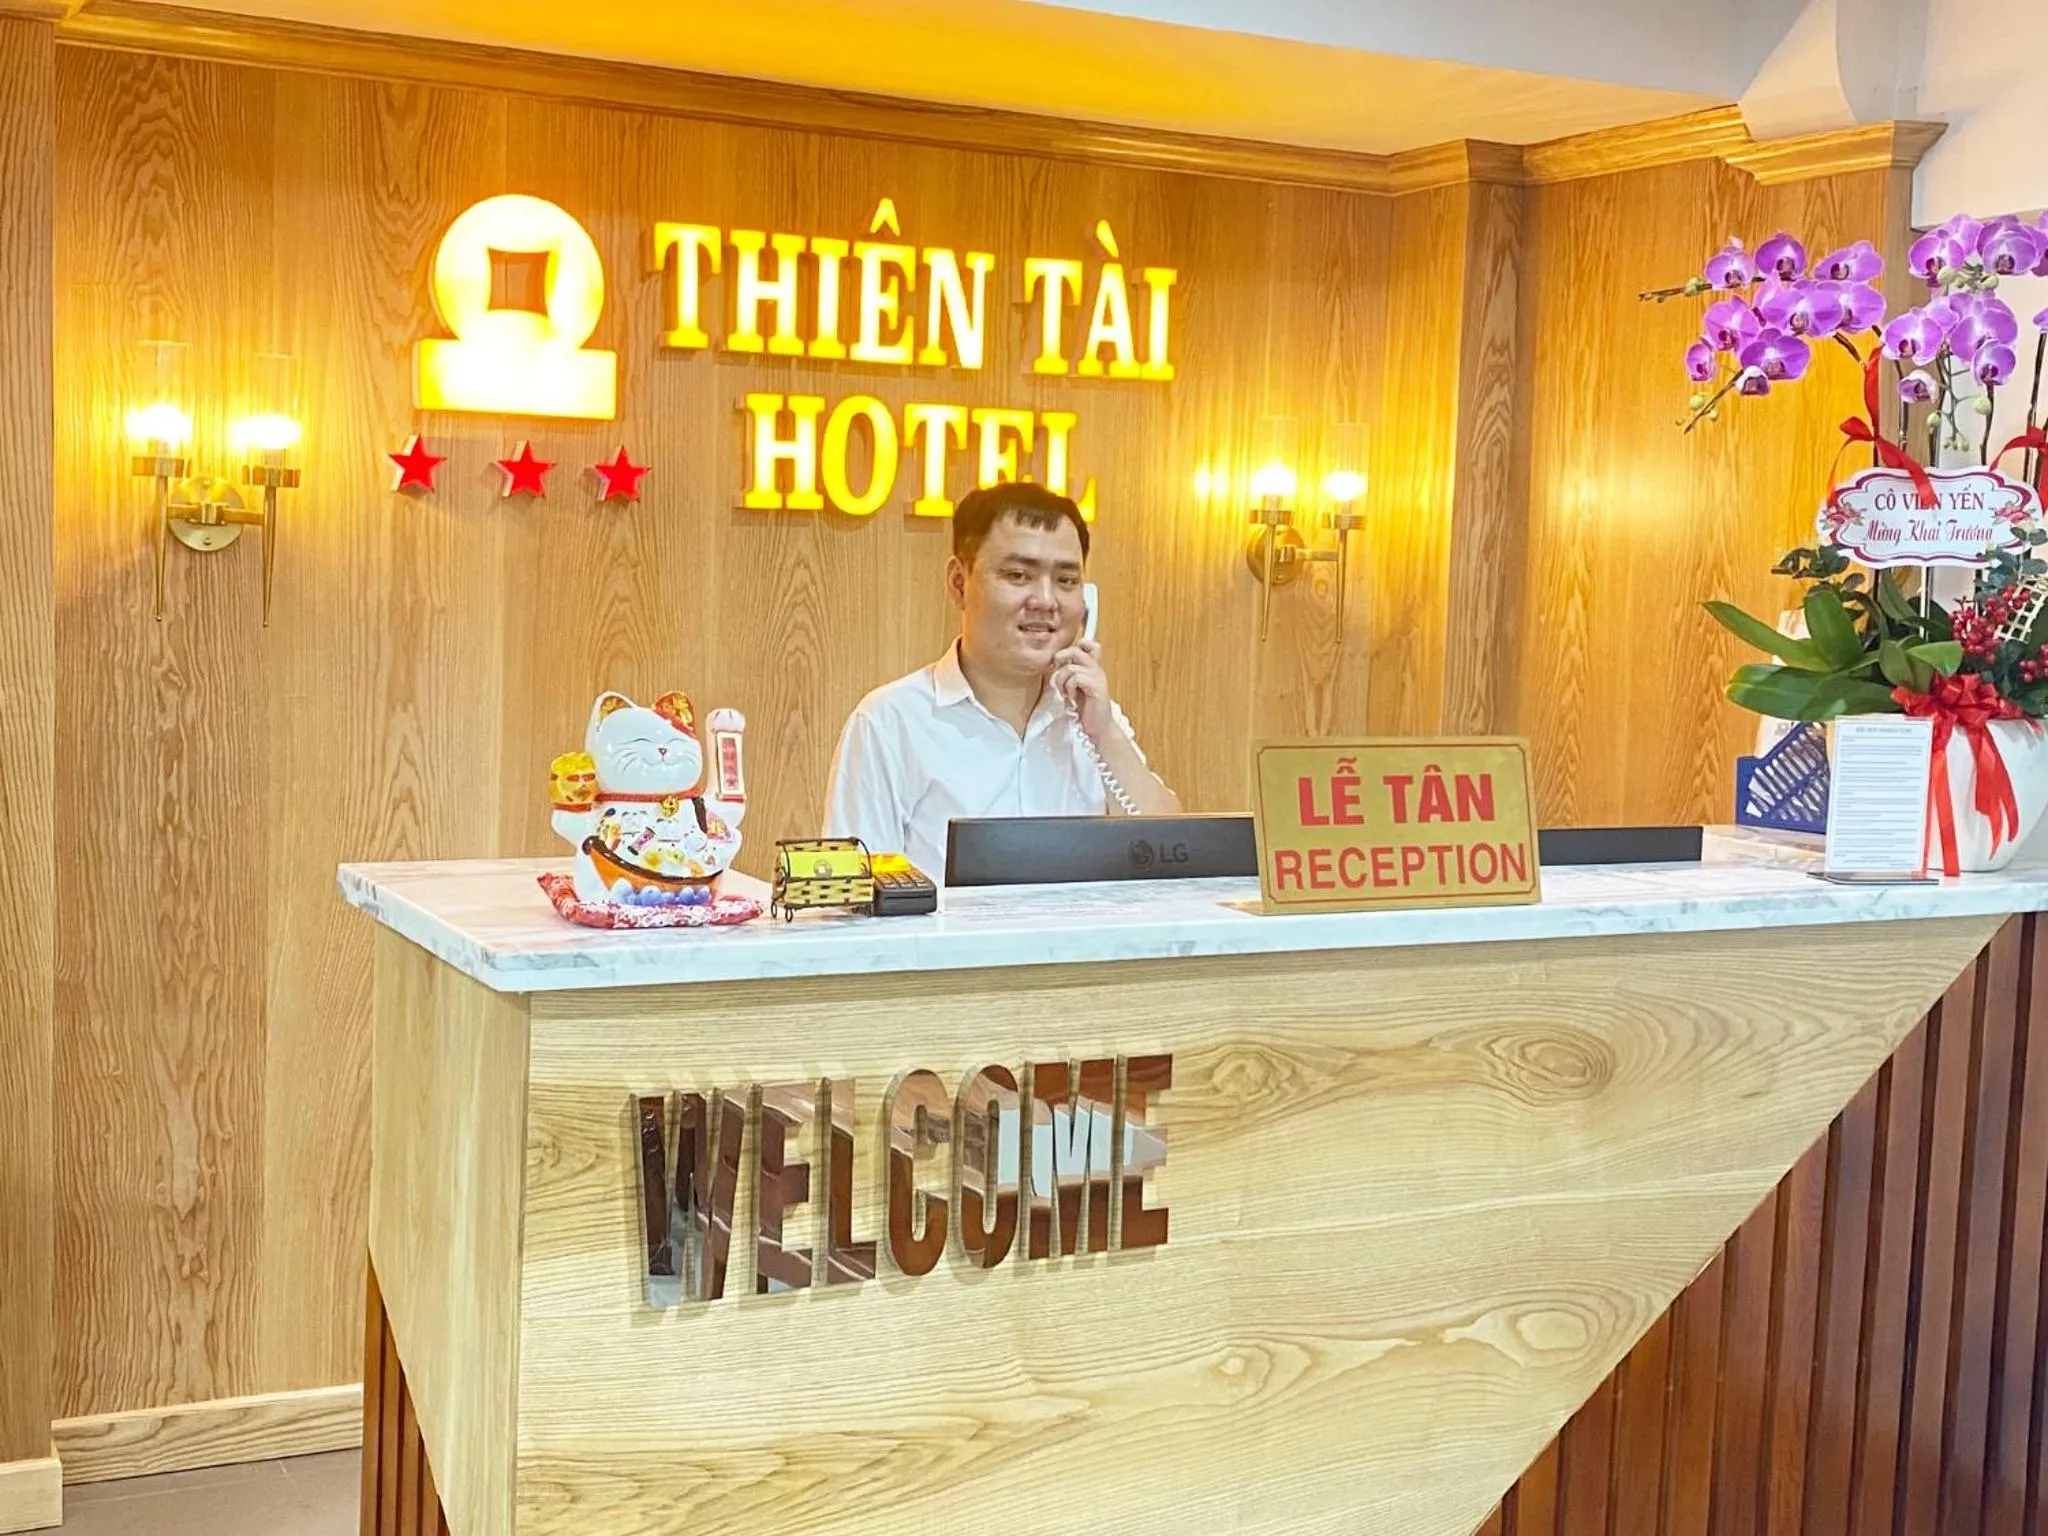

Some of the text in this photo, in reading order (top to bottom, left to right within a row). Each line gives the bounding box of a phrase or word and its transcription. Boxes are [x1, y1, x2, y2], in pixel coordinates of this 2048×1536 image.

[654, 197, 1178, 382] THIÊN TÀI
[743, 393, 1097, 523] HOTEL
[1874, 488, 1897, 511] CÔ
[1949, 483, 1985, 511] YẾN
[1905, 519, 1942, 542] Khai
[1297, 757, 1495, 826] LỄ TÂN
[1159, 842, 1189, 863] LG
[1274, 842, 1528, 890] RECEPTION
[629, 1054, 1174, 1308] WELCOME
